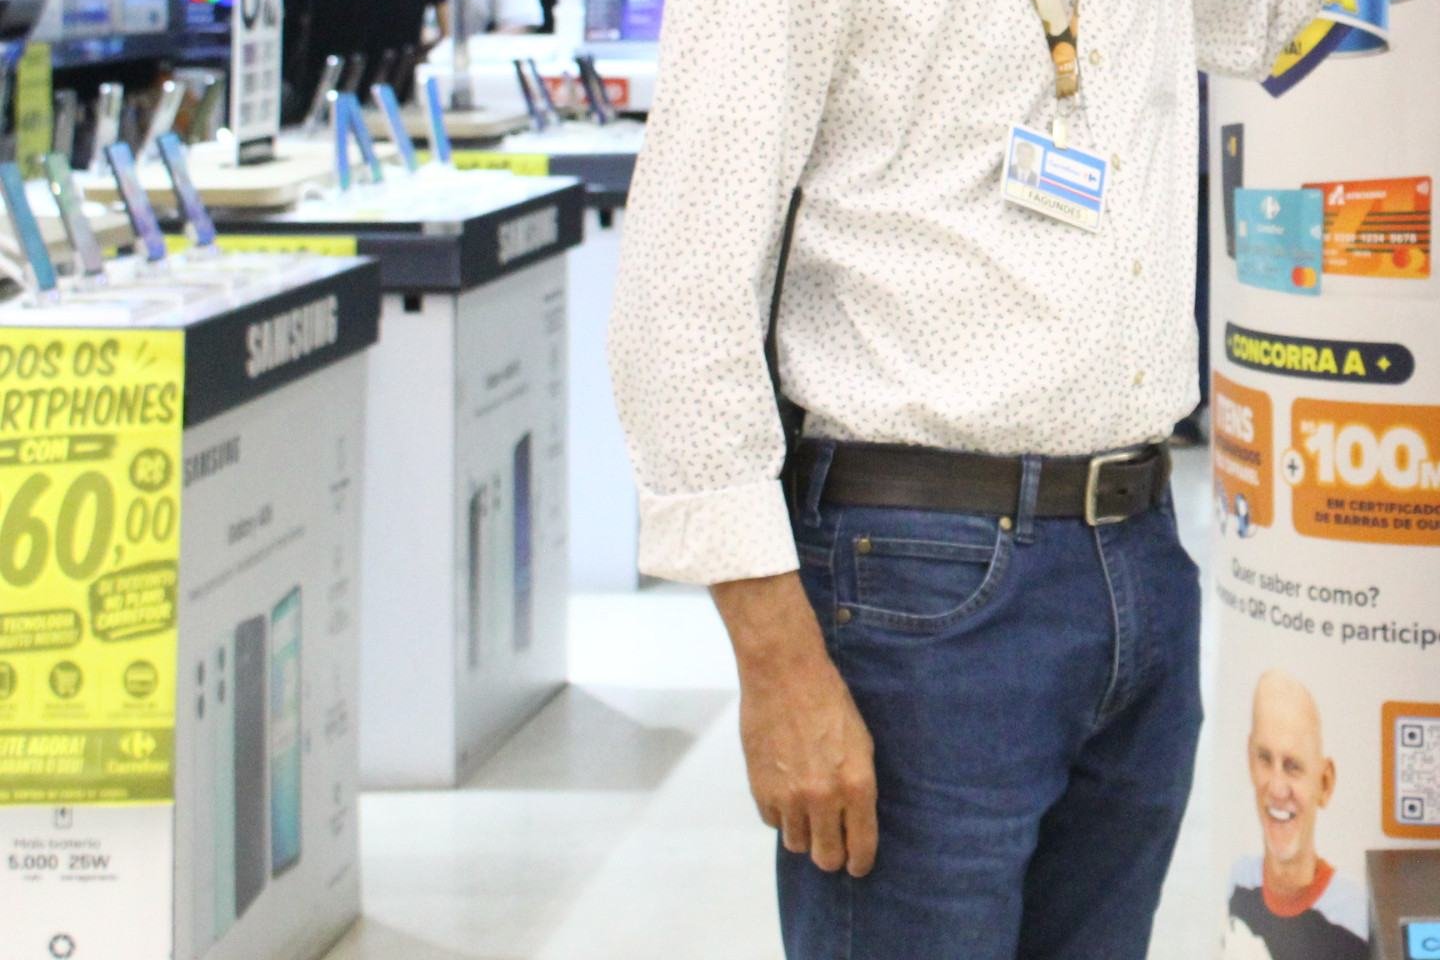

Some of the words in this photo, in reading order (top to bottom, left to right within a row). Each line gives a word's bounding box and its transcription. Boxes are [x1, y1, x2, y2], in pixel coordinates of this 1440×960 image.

[246, 295, 339, 378] SAMSUNG
[1232, 334, 1338, 374] CONCORRA
[1343, 349, 1366, 376] A
[72, 338, 120, 377] OS
[0, 381, 177, 431] RTPHONES
[1305, 415, 1427, 489] 100
[1315, 512, 1330, 523] DE
[1334, 514, 1389, 528] BARRAS
[1393, 518, 1413, 530] DE
[1327, 498, 1345, 509] EM
[1259, 573, 1302, 598] saber
[1307, 585, 1380, 609] como?
[1248, 596, 1267, 621] QR
[1271, 605, 1316, 634] Code
[1321, 620, 1335, 637] e
